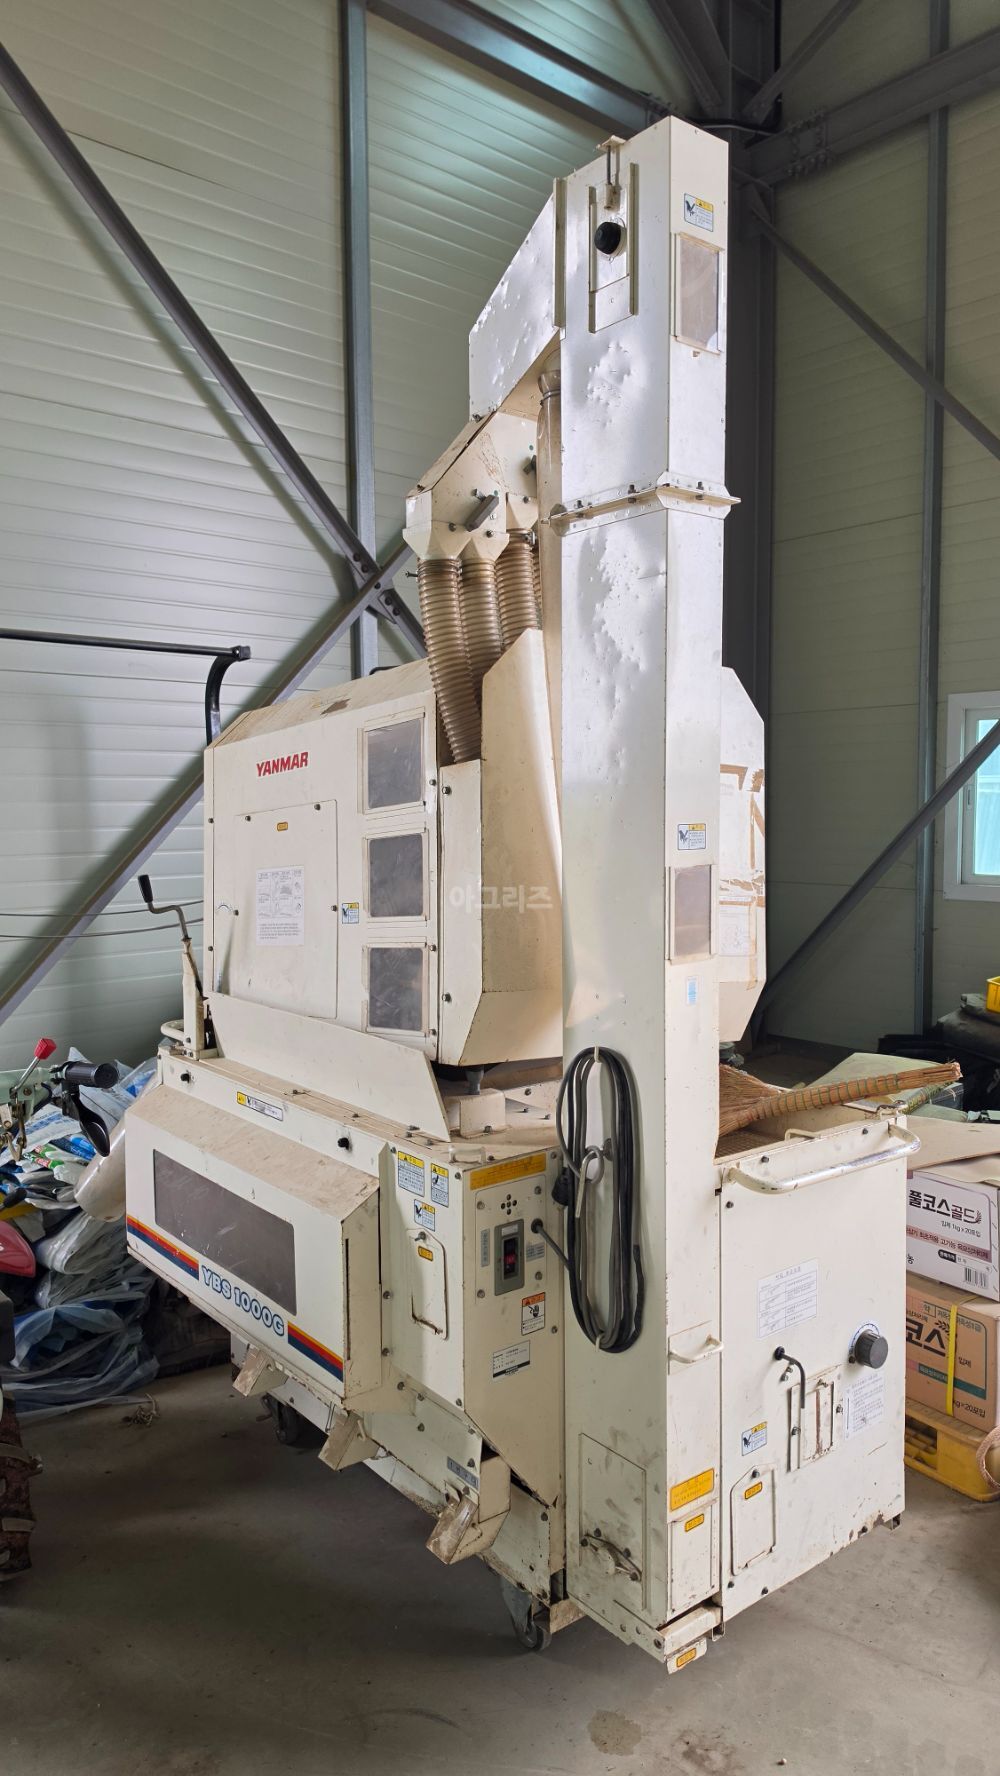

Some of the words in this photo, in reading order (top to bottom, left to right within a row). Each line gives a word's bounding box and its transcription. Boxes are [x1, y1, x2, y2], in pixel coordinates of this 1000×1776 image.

[256, 751, 309, 777] YANMAR
[908, 1189, 981, 1224] 풀코스골드
[201, 1264, 232, 1300] YBS
[233, 1286, 285, 1337] 1000G
